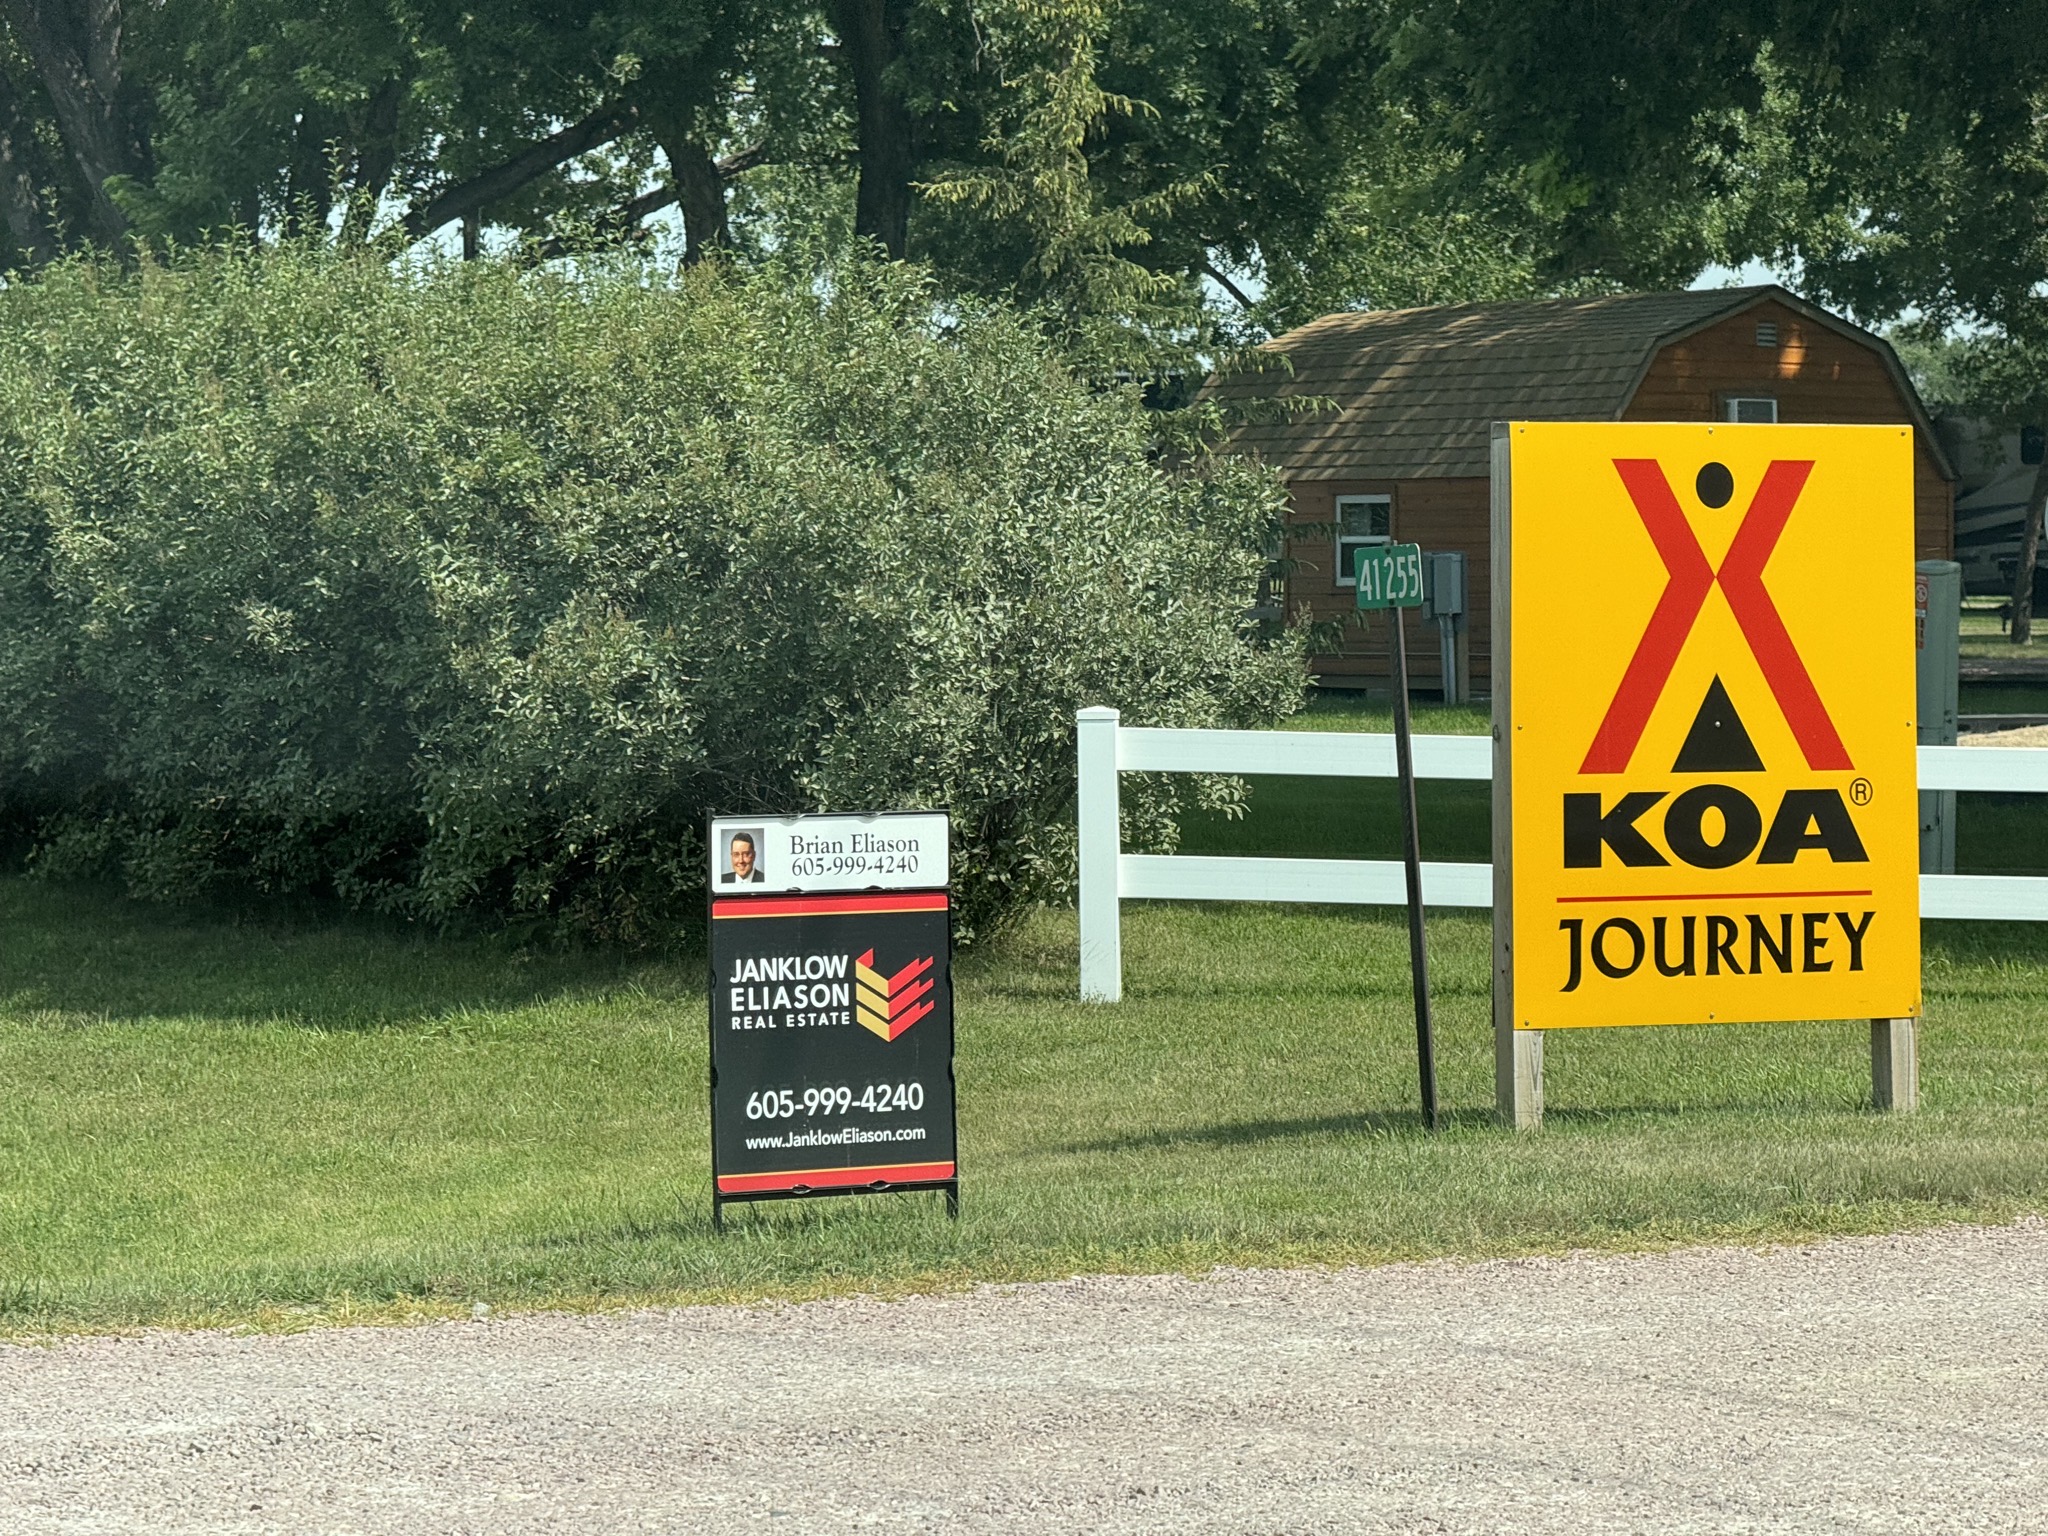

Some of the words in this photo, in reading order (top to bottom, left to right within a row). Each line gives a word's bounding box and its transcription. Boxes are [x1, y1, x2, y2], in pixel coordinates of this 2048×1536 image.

[1360, 554, 1419, 601] 41255
[1563, 784, 1870, 869] KOA
[790, 834, 844, 855] Brian
[850, 833, 920, 854] Eliason
[791, 855, 919, 876] 605-999-4240
[1559, 911, 1876, 993] JOURNEY
[730, 955, 848, 983] JANKLOW
[731, 983, 849, 1011] ELIASON
[731, 1014, 776, 1030] REAL
[786, 1011, 850, 1027] ESTATE
[746, 1083, 924, 1119] 605-999-4240
[746, 1127, 926, 1150] www.JanklowEliason.com
